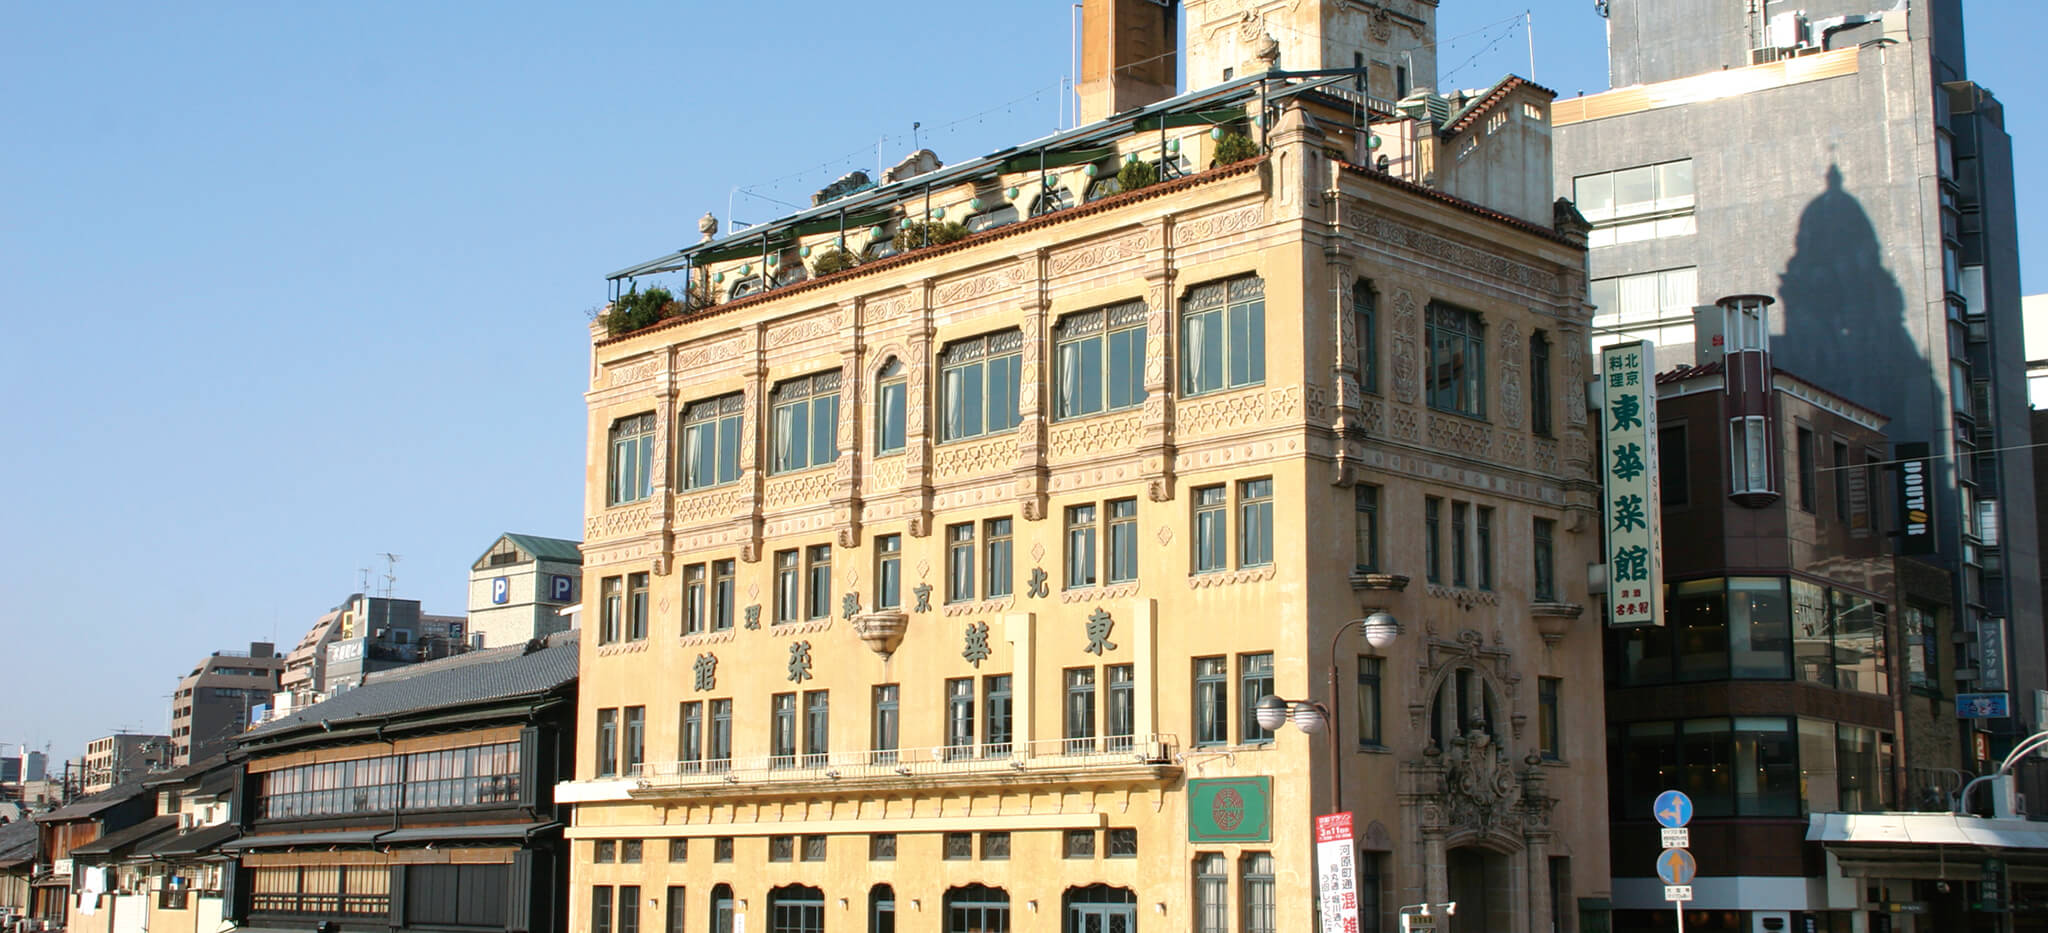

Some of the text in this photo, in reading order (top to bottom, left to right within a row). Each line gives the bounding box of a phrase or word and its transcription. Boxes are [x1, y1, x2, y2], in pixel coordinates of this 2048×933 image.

[1610, 394, 1648, 582] 東華菜館
[1904, 461, 1929, 535] DOUTOR
[496, 580, 506, 602] P
[557, 578, 570, 599] P
[1340, 845, 1353, 889] 河原町通
